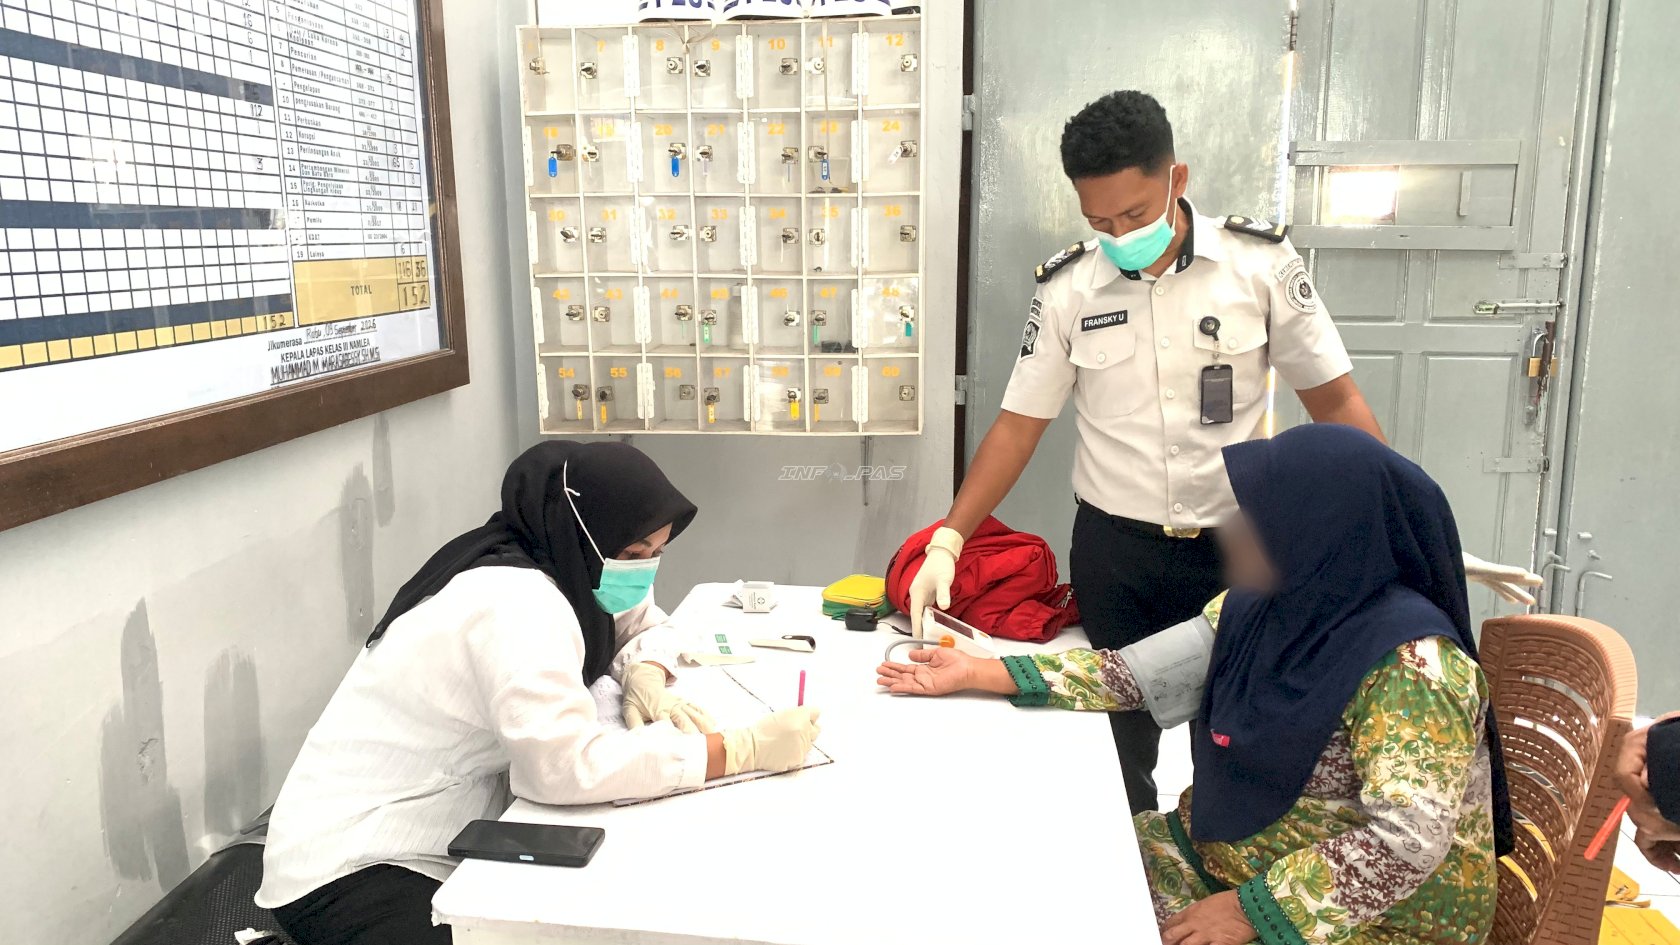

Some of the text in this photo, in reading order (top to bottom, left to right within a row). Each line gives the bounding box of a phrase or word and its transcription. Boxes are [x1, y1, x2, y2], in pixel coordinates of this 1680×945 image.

[767, 37, 788, 52] 10
[885, 33, 905, 48] 12
[285, 131, 293, 139] 12
[767, 120, 787, 136] 22
[881, 118, 903, 134] 24
[711, 208, 730, 221] 33
[350, 285, 373, 296] TOTAL
[403, 284, 429, 307] 152
[263, 314, 287, 330] 152
[1084, 312, 1125, 328] FRANSKY U
[280, 349, 306, 363] KEPALA
[305, 346, 324, 360] LAPAS
[324, 343, 343, 356] KELAS
[349, 337, 371, 350] NAMLEA
[557, 366, 577, 380] 54
[609, 365, 631, 380] 55
